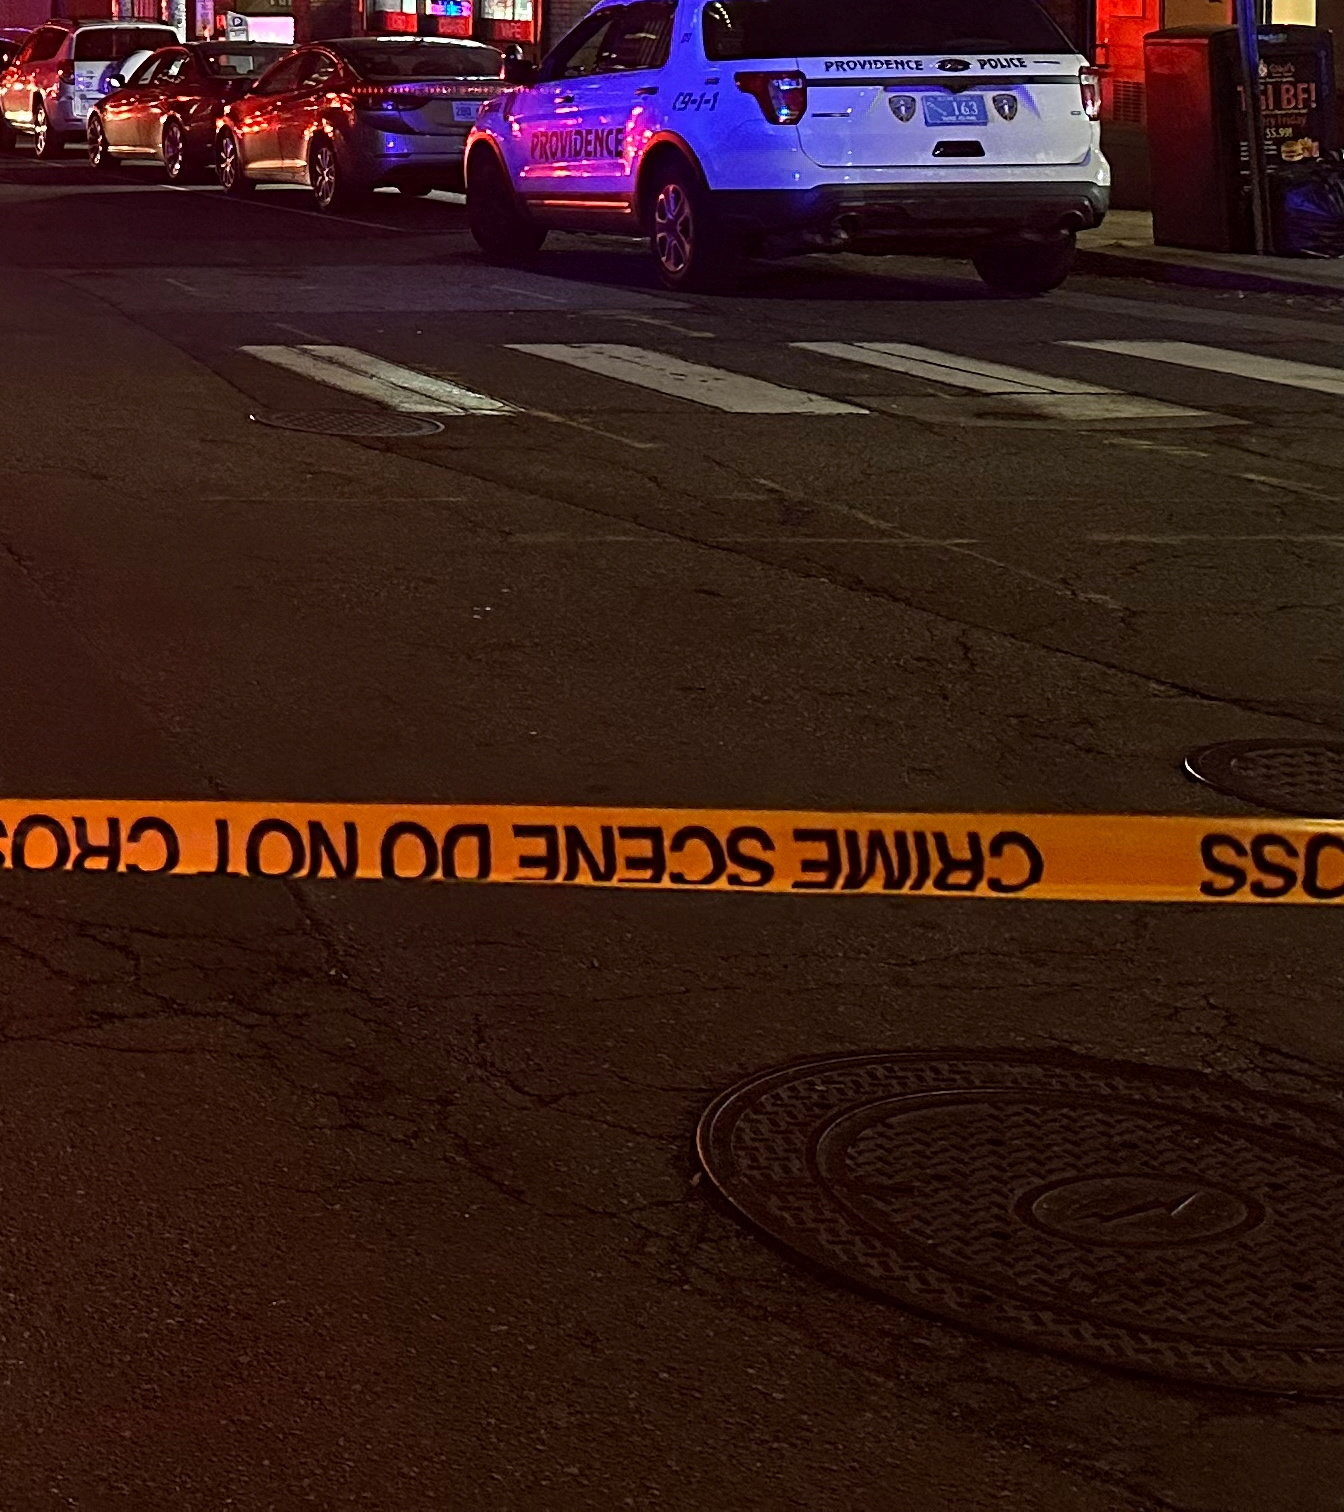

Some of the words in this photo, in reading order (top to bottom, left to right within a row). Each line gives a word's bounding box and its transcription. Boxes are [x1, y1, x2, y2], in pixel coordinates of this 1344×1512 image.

[824, 60, 924, 72] PROVIDENCE
[977, 57, 1028, 70] POLICE
[530, 128, 624, 162] PROVIDENCE
[204, 817, 358, 879] NOT
[380, 821, 492, 881] DO
[512, 823, 776, 888] SCENE
[791, 827, 1045, 893] CRIME
